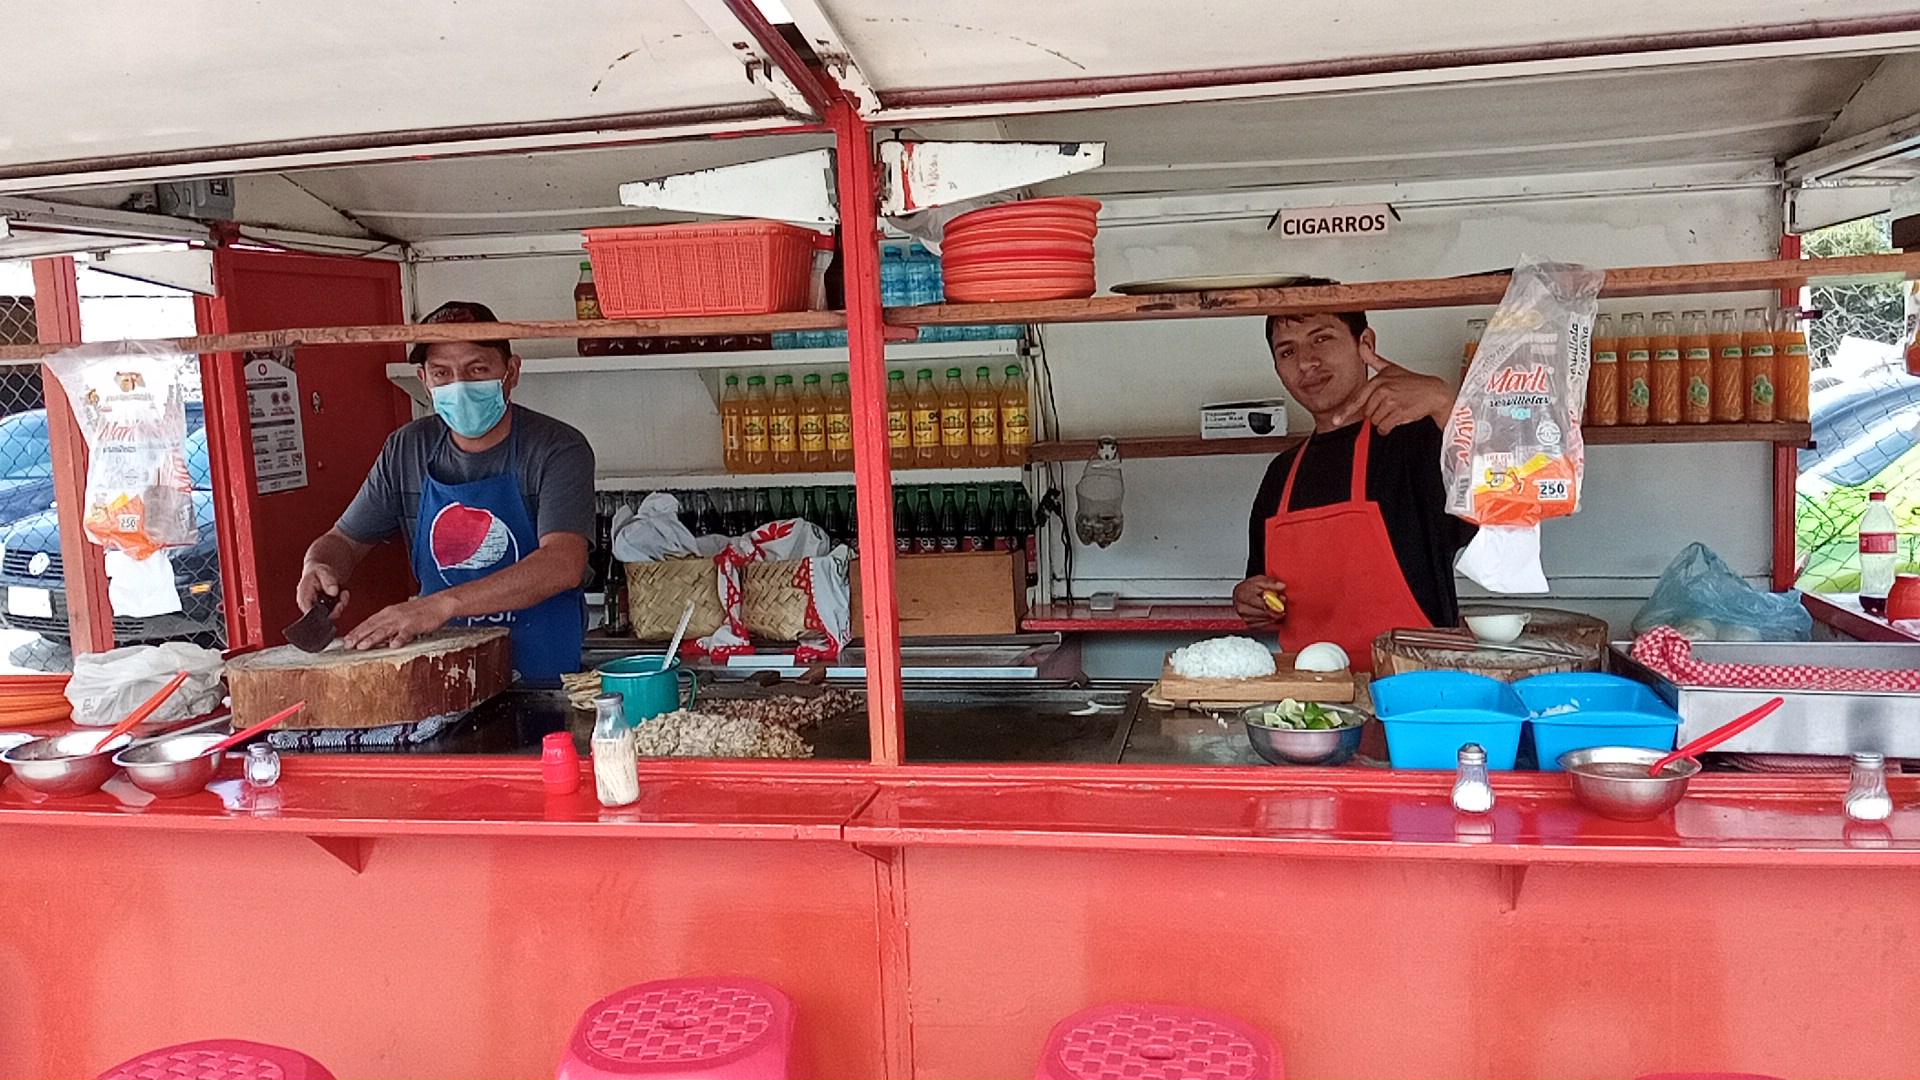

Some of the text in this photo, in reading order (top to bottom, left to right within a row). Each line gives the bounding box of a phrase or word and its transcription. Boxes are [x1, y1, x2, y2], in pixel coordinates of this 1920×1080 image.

[1283, 214, 1385, 235] CIGARROS
[1540, 483, 1565, 495] 250
[120, 518, 136, 528] 250
